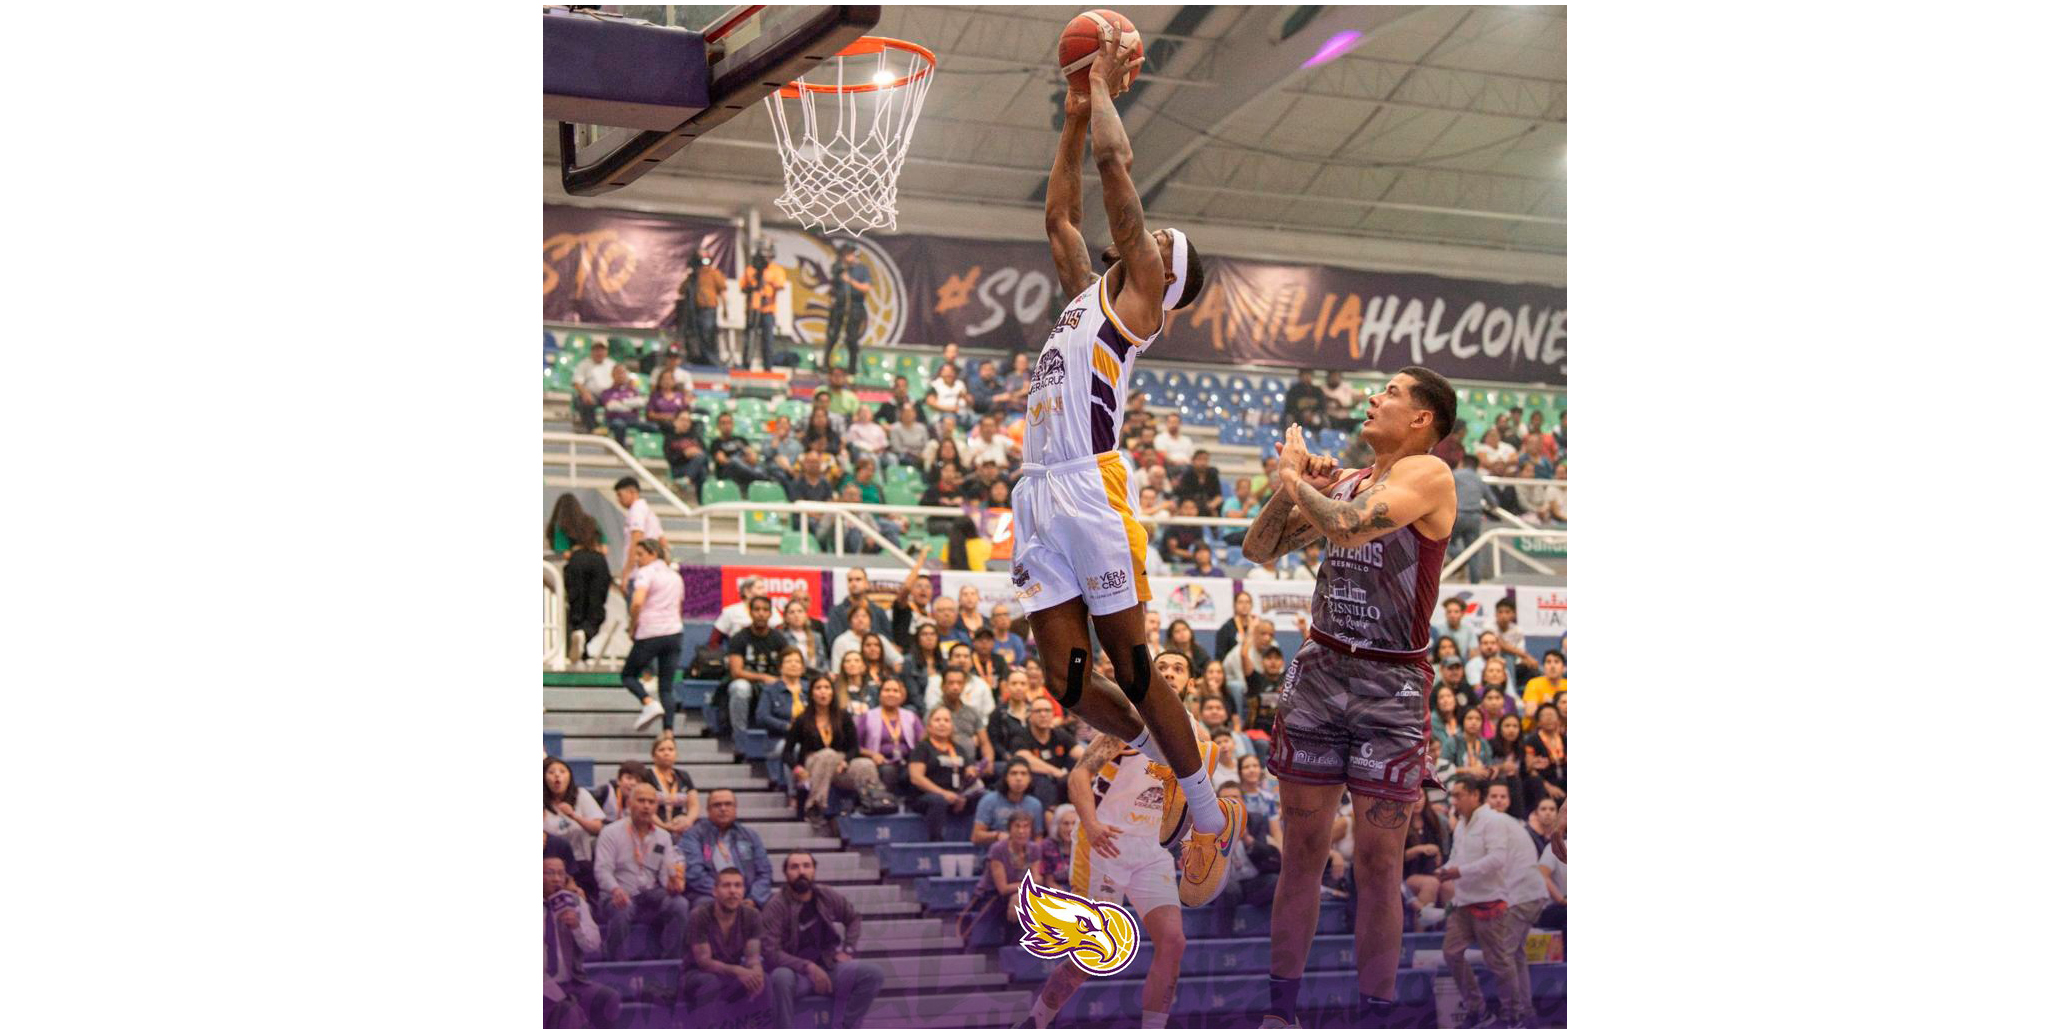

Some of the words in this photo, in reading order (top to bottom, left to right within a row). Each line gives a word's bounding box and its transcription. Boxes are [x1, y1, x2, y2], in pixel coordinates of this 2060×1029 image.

[542, 229, 637, 298] TO
[1359, 294, 1567, 375] HALCONE
[1100, 569, 1125, 581] VERA
[1102, 577, 1126, 589] CRUZ
[1282, 659, 1299, 702] molten
